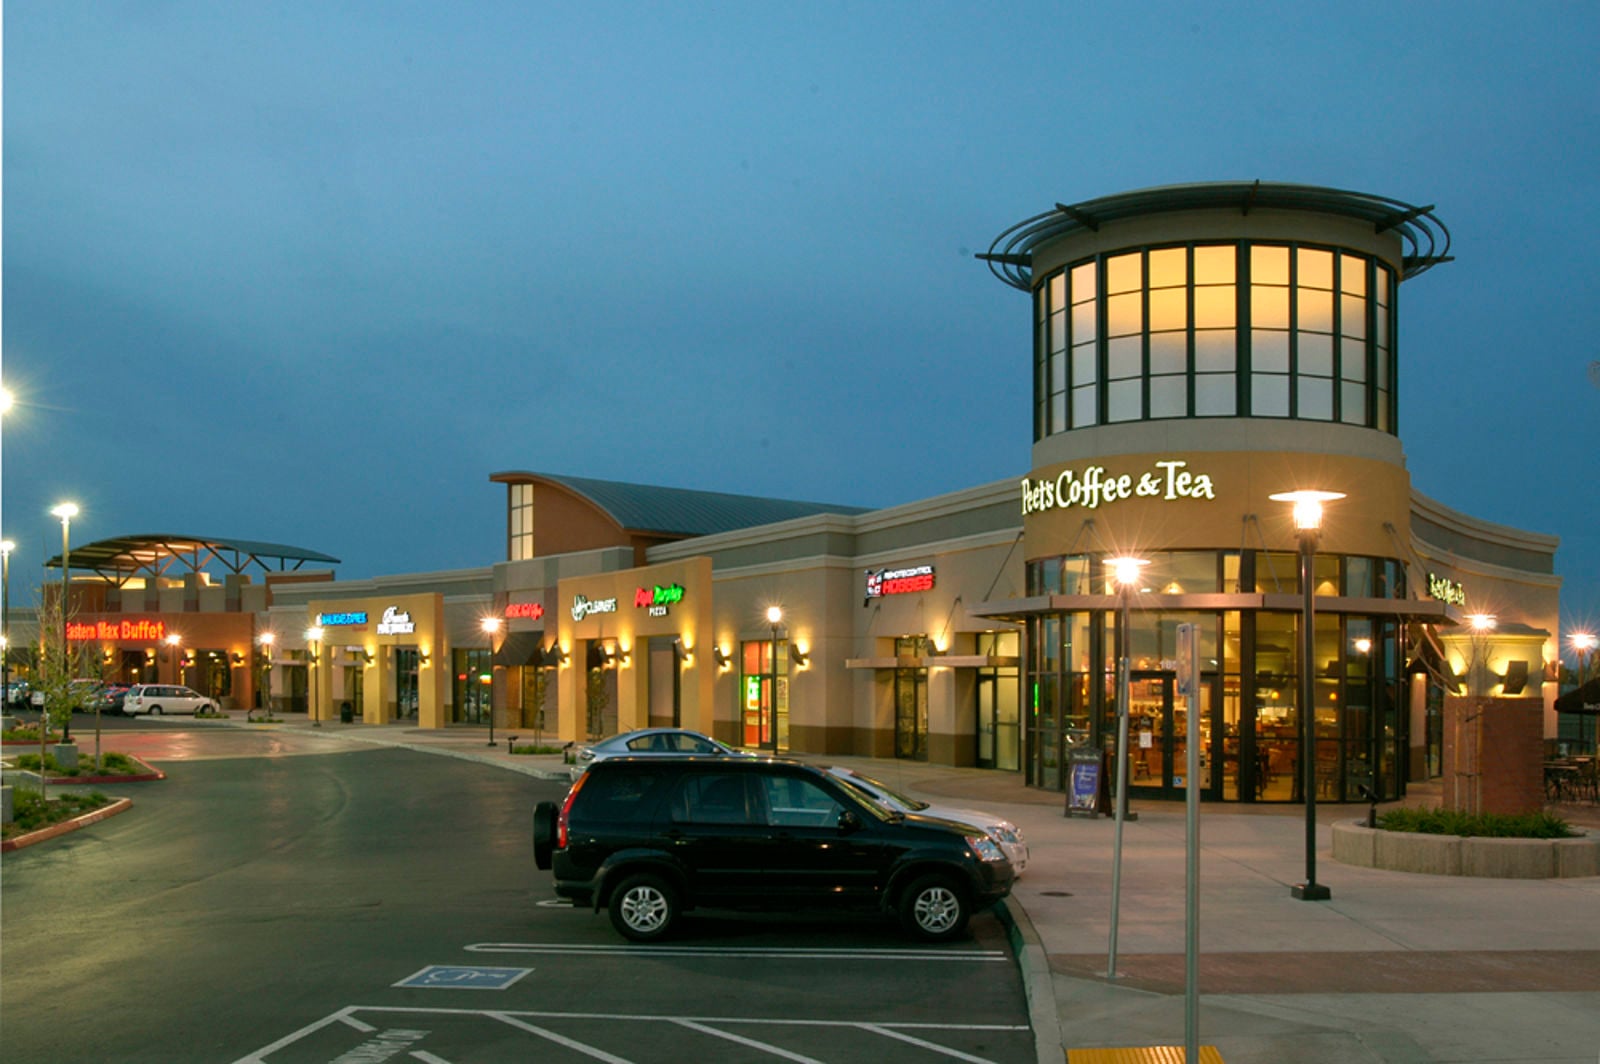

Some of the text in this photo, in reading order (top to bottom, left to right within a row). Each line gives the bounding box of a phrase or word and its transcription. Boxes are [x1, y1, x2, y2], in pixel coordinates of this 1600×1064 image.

[1021, 461, 1215, 515] Peet's Coffee & Tea
[882, 574, 933, 595] HOBBIES
[649, 606, 667, 616] PIZZA
[66, 620, 164, 639] Eastern Max Buffet
